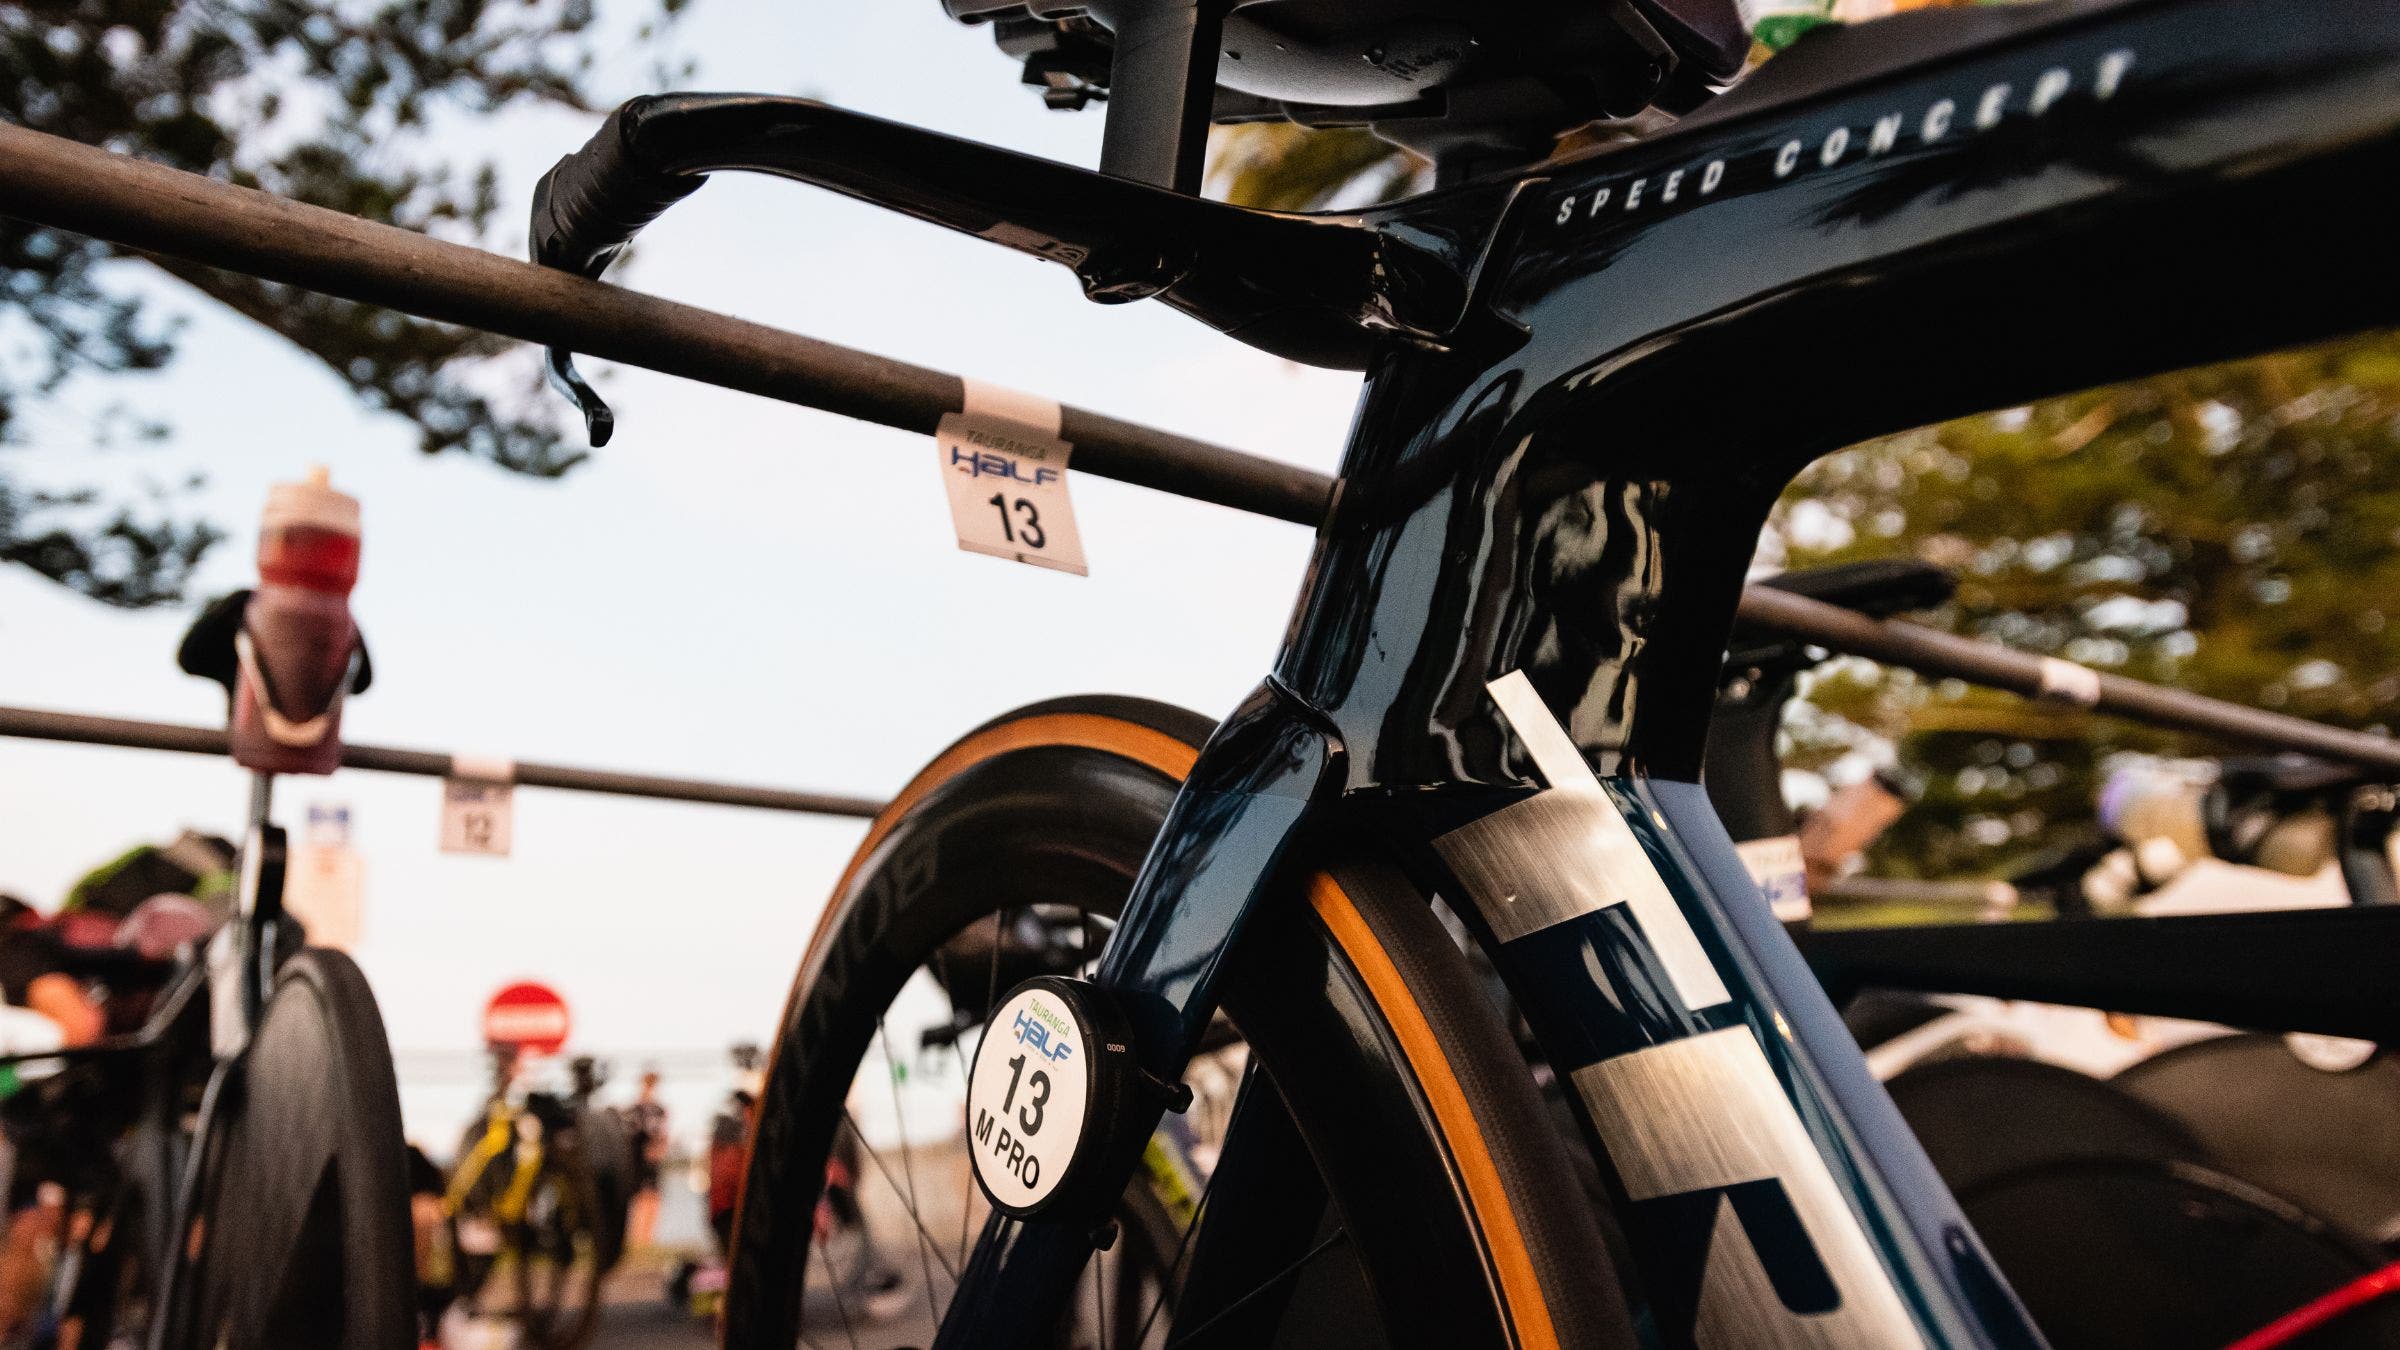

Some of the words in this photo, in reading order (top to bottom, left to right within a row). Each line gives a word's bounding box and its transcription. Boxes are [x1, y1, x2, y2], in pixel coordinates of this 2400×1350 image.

[1556, 160, 1726, 226] SPEED
[1773, 48, 2135, 180] CONCEPT
[989, 492, 1046, 549] 13
[1028, 998, 1071, 1038] TAURANGA
[1002, 1054, 1051, 1136] 13
[975, 1108, 995, 1146] M
[994, 1127, 1040, 1189] PRO
